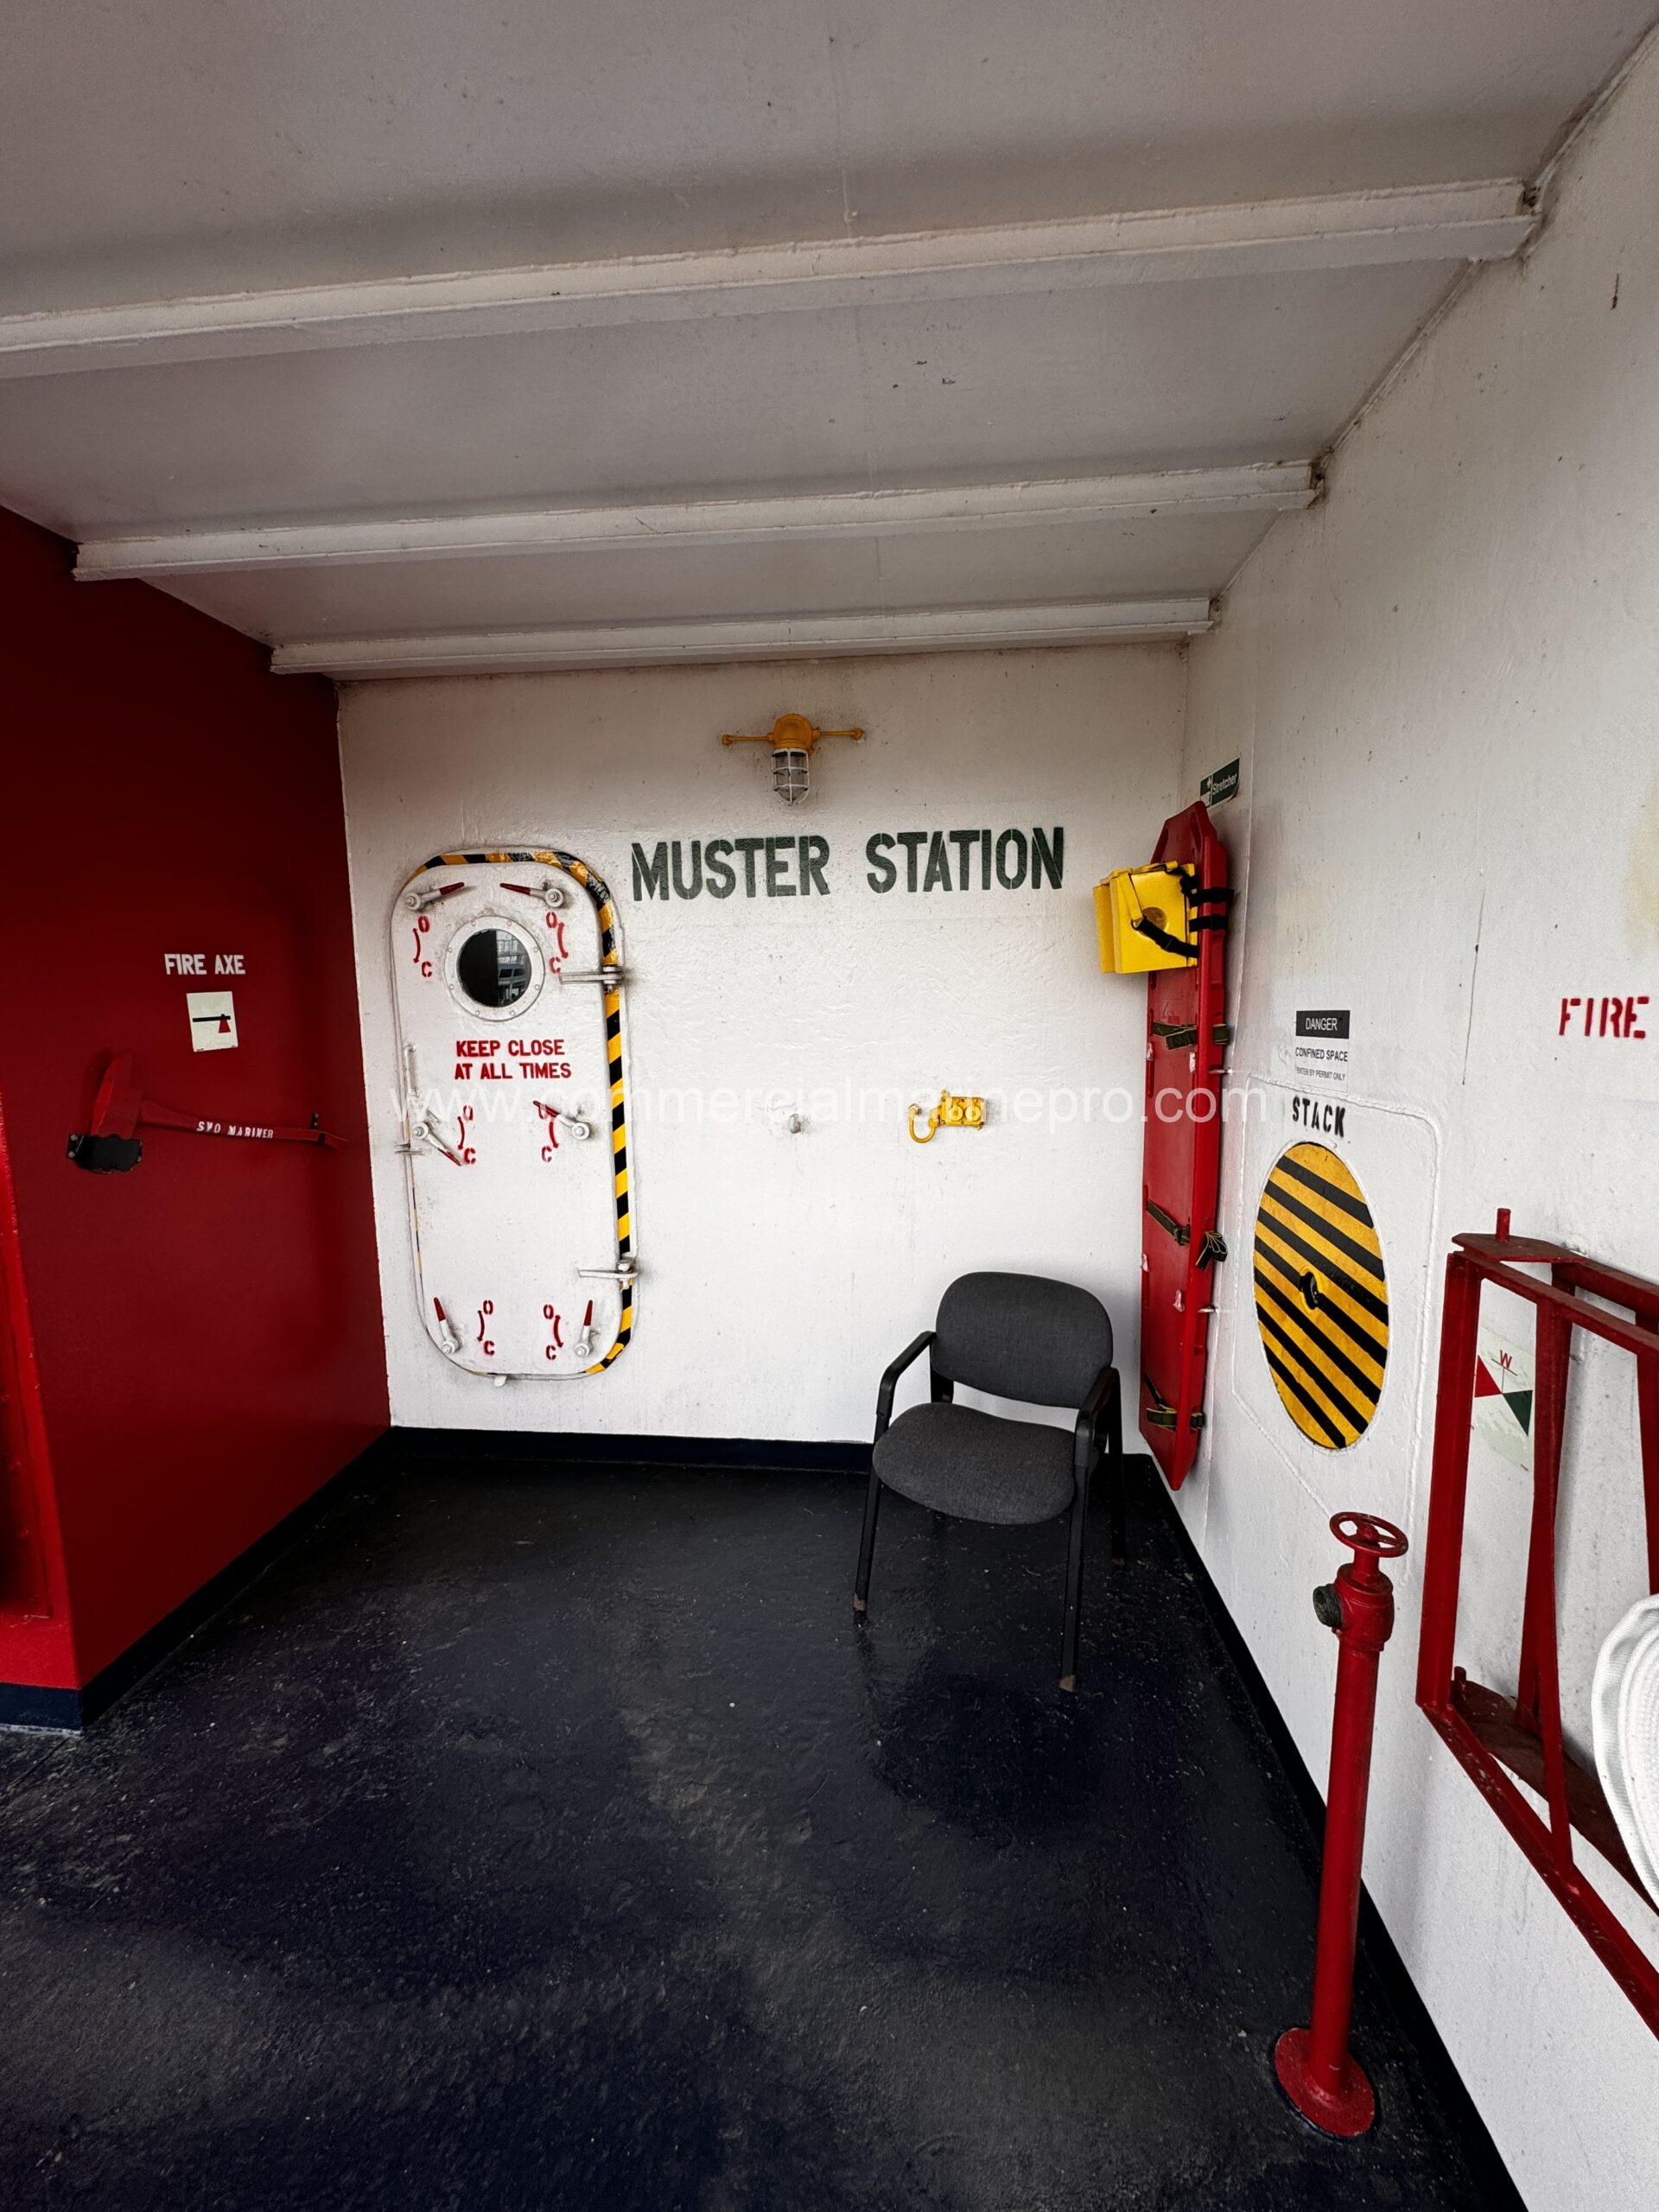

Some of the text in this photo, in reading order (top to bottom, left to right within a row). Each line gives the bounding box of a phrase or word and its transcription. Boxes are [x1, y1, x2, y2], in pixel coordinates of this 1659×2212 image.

[1212, 773, 1237, 795] Stretcher
[632, 827, 1064, 901] MUSTER STATION
[417, 916, 430, 932] O
[545, 912, 557, 928] O
[164, 953, 245, 975] FIRE AXE
[421, 961, 432, 977] C
[550, 957, 561, 974] C
[1306, 1018, 1338, 1031] DANGER
[1559, 996, 1649, 1039] FIRE
[456, 1039, 565, 1058] KEEP CLOSE
[1295, 1046, 1348, 1062] CONFINED SPACE
[454, 1062, 572, 1080] AT ALL TIMES
[1315, 1070, 1332, 1079] PERMIT
[1333, 1071, 1346, 1081] ONLY
[1292, 1096, 1345, 1138] STACK
[227, 1125, 274, 1139] MARINER
[464, 1147, 476, 1164] C
[541, 1146, 552, 1162] C
[483, 1300, 493, 1314] O
[543, 1304, 554, 1319] O
[484, 1340, 494, 1355] C
[546, 1345, 556, 1360] C
[1499, 1349, 1513, 1370] W
